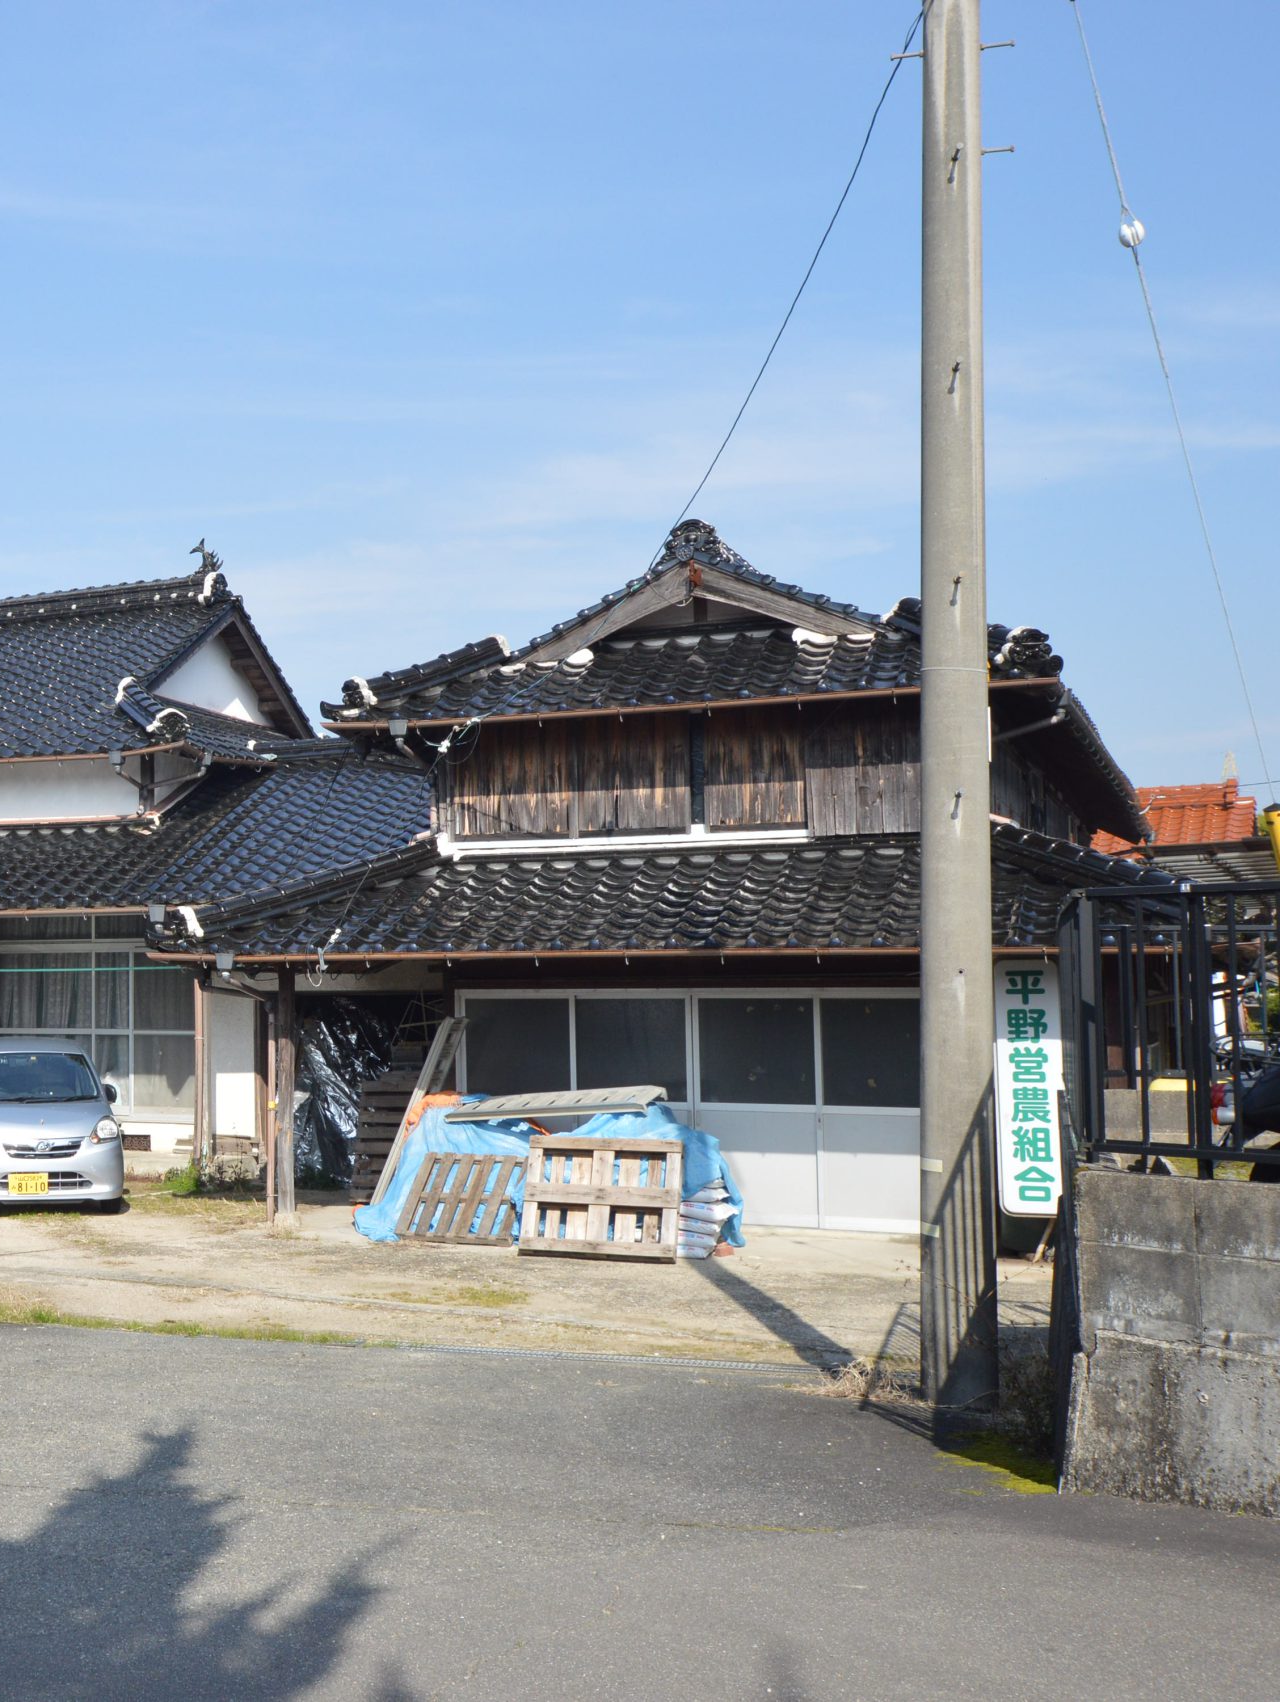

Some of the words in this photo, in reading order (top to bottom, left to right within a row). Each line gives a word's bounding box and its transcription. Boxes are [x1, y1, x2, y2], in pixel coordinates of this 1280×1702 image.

[1005, 969, 1056, 1203] 平野営農組合
